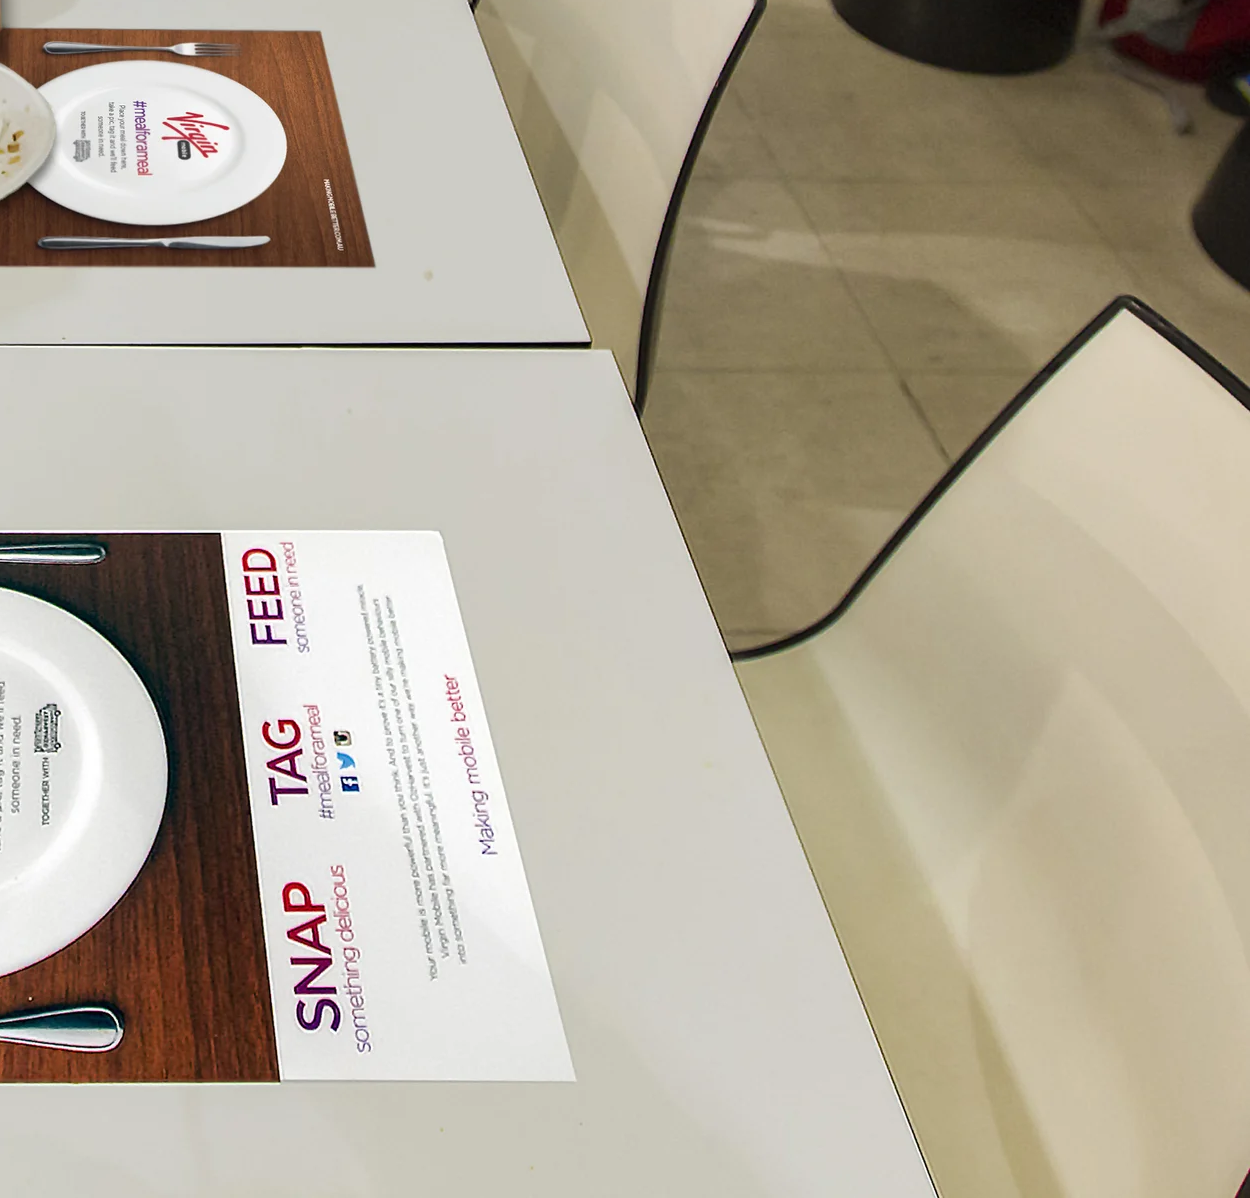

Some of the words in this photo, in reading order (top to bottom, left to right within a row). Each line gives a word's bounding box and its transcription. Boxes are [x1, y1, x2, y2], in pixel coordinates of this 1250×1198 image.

[107, 126, 115, 134] tag
[119, 130, 127, 141] meal
[133, 101, 153, 176] #mealforameal
[161, 112, 230, 158] Virgin
[279, 542, 297, 574] need
[286, 576, 298, 588] in
[242, 548, 287, 644] FEED
[288, 590, 310, 653] someone
[444, 674, 466, 722] better
[11, 747, 20, 757] in
[262, 719, 309, 806] TAG
[303, 704, 335, 819] #mealforameal
[454, 727, 480, 784] mobile
[10, 761, 20, 813] someone
[42, 781, 50, 825] TOGETHER
[471, 790, 498, 855] Making
[330, 865, 354, 942] delicious
[282, 882, 341, 1032] SNAP
[342, 947, 371, 1053] something
